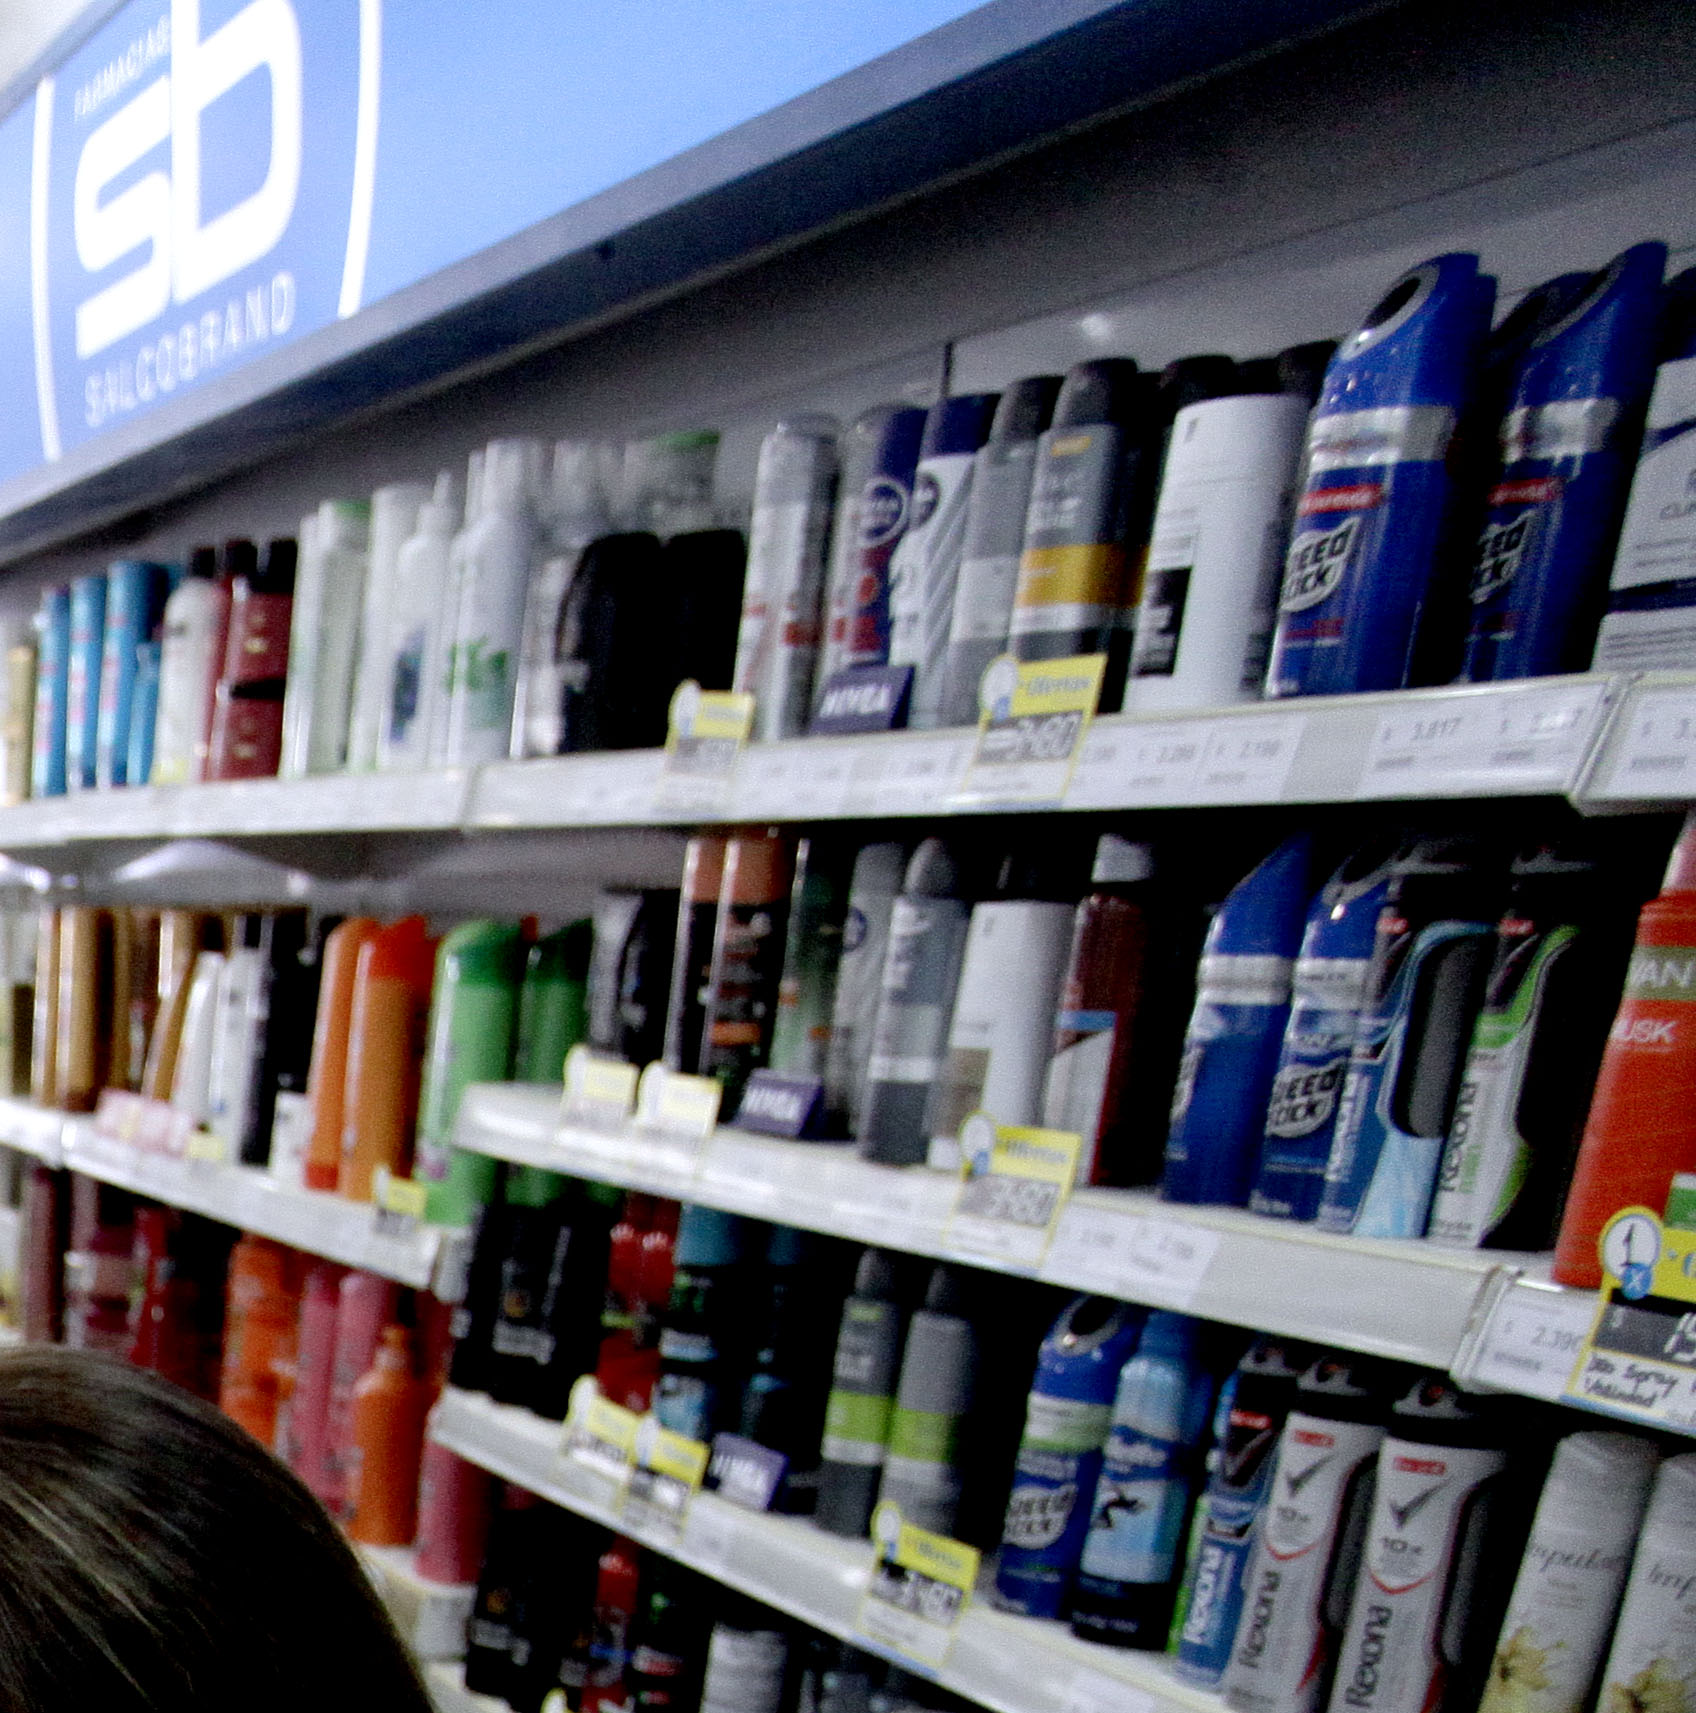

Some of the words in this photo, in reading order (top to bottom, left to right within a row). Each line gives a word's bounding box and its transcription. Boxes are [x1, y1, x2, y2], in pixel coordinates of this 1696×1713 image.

[84, 271, 296, 428] SALCOBRAND
[1612, 1019, 1677, 1043] USK
[1239, 1570, 1283, 1669] Rexona
[1344, 1605, 1393, 1708] Rexona
